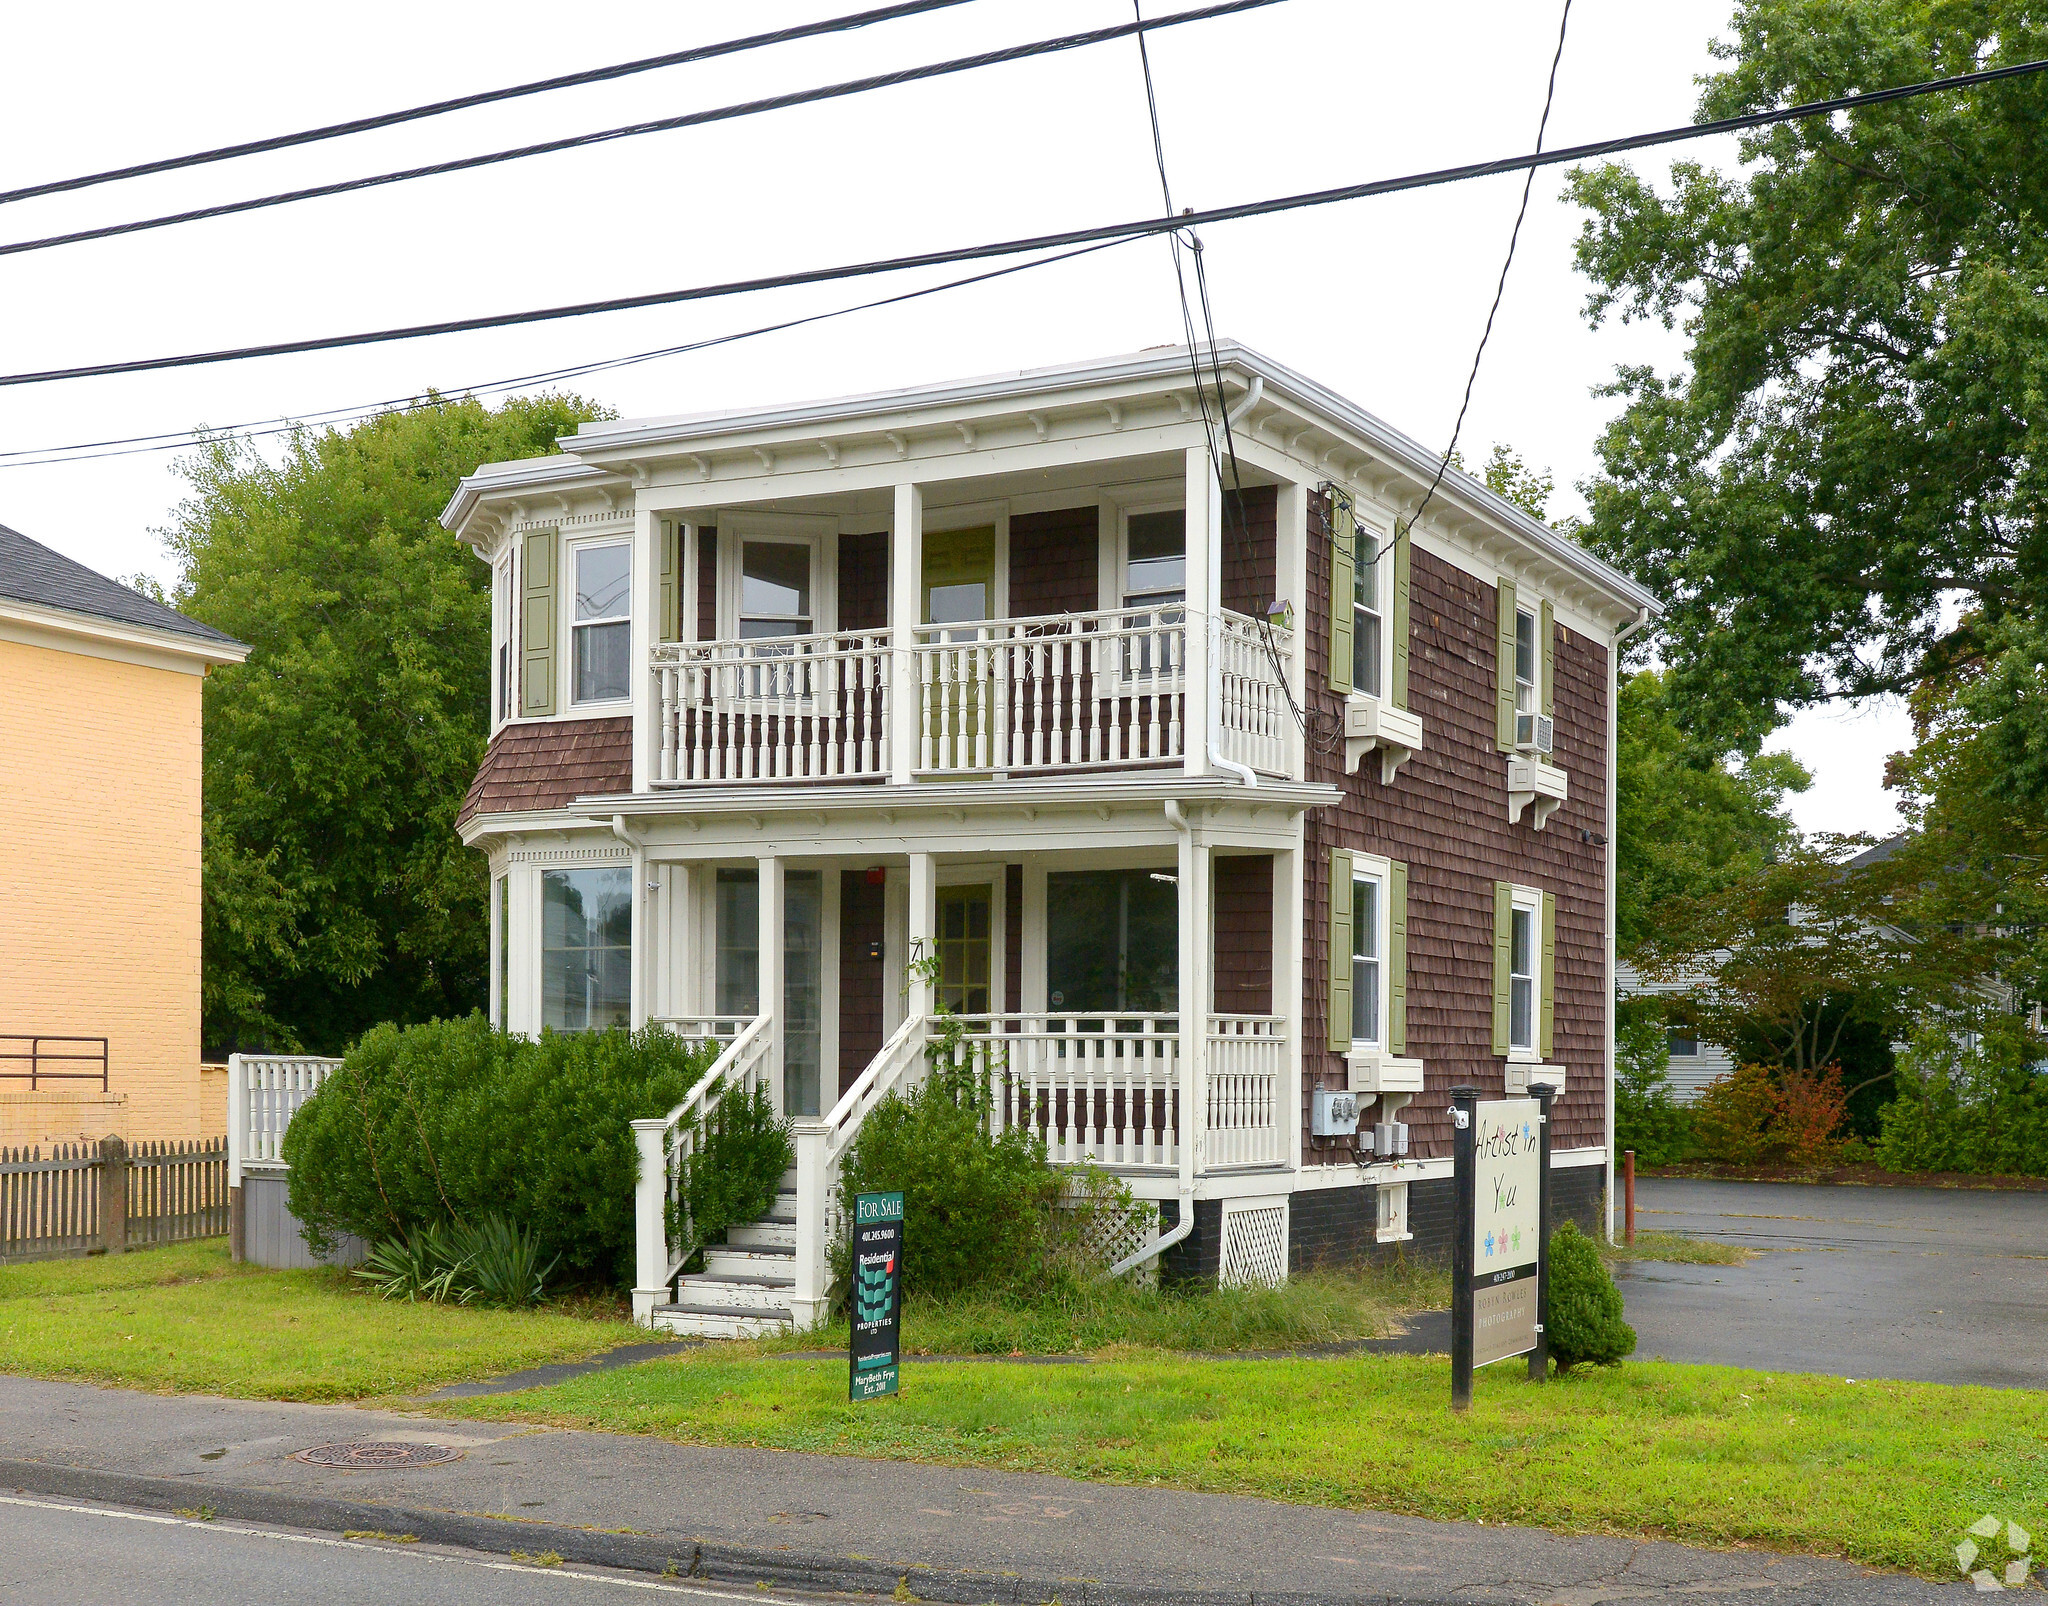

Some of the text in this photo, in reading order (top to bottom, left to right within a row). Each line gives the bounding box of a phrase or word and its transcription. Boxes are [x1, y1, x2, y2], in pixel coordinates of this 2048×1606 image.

[1476, 1119, 1536, 1160] Artist in
[859, 1198, 901, 1218] FOR SALE
[862, 1229, 895, 1242] 401.245.9600
[859, 1250, 895, 1266] Residential
[857, 1317, 892, 1331] PROPERTIES
[1478, 1306, 1526, 1329] PHOTOGRAPHY
[855, 1370, 895, 1386] MaryBeth Frye
